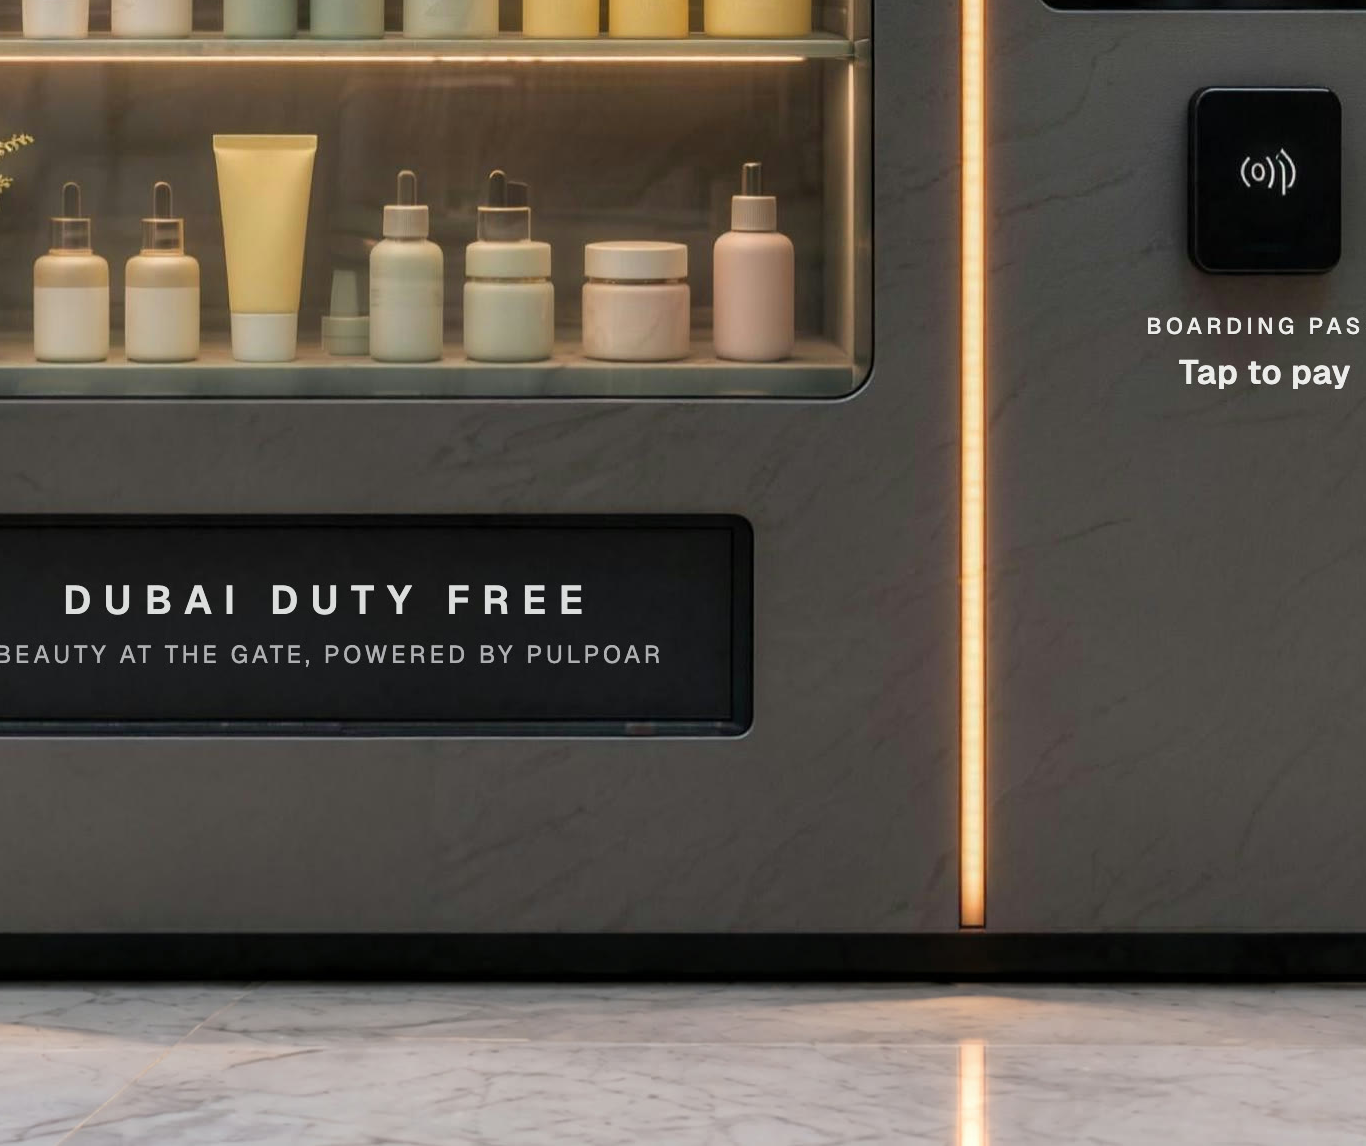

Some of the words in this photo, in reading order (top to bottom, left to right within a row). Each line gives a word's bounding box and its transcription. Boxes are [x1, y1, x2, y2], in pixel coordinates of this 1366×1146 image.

[1147, 316, 1294, 336] BOARDING
[1178, 359, 1238, 390] Tap
[1247, 360, 1282, 386] to
[1292, 364, 1351, 390] pay
[65, 584, 234, 616] DUBAI
[272, 584, 413, 616] DUTY
[448, 584, 583, 615] FREE
[119, 644, 152, 664] AT
[164, 644, 217, 664] THE
[230, 644, 311, 669] GATE,
[325, 644, 465, 665] POWERED
[480, 644, 514, 664] BY
[527, 644, 660, 665] PULPOAR
